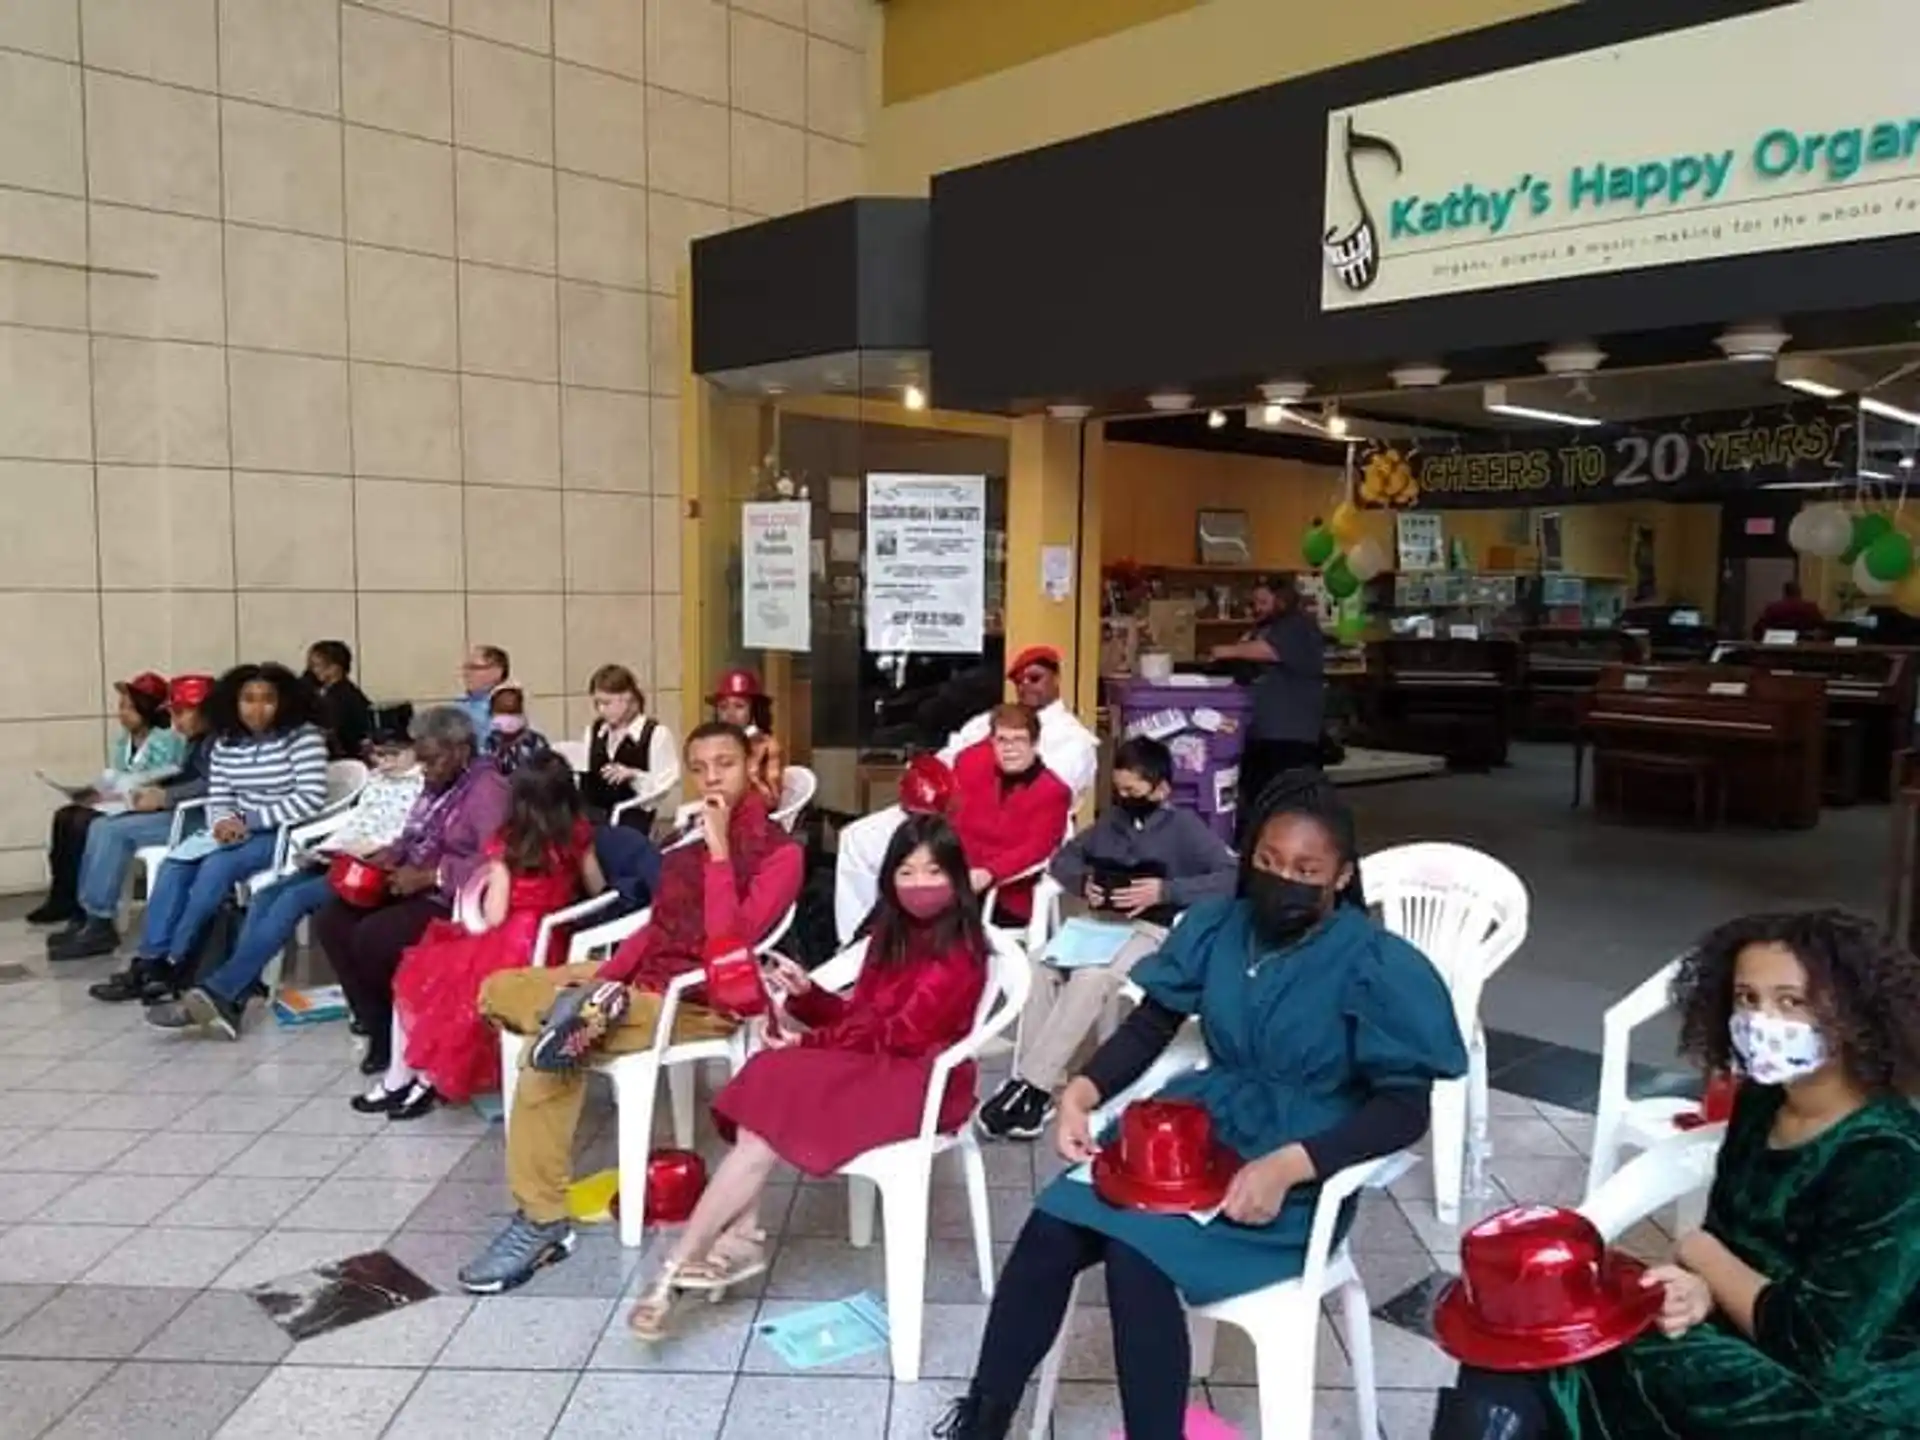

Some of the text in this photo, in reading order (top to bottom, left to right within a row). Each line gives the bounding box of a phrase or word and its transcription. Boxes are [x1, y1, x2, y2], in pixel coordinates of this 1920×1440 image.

[1390, 173, 1551, 239] Kathy's
[1568, 150, 1734, 209] Happy
[1734, 215, 1762, 234] for
[1773, 212, 1806, 231] the
[1818, 201, 1882, 222] whole
[1421, 452, 1550, 492] CHEERS
[1558, 446, 1607, 488] TO
[1613, 433, 1690, 487] 20
